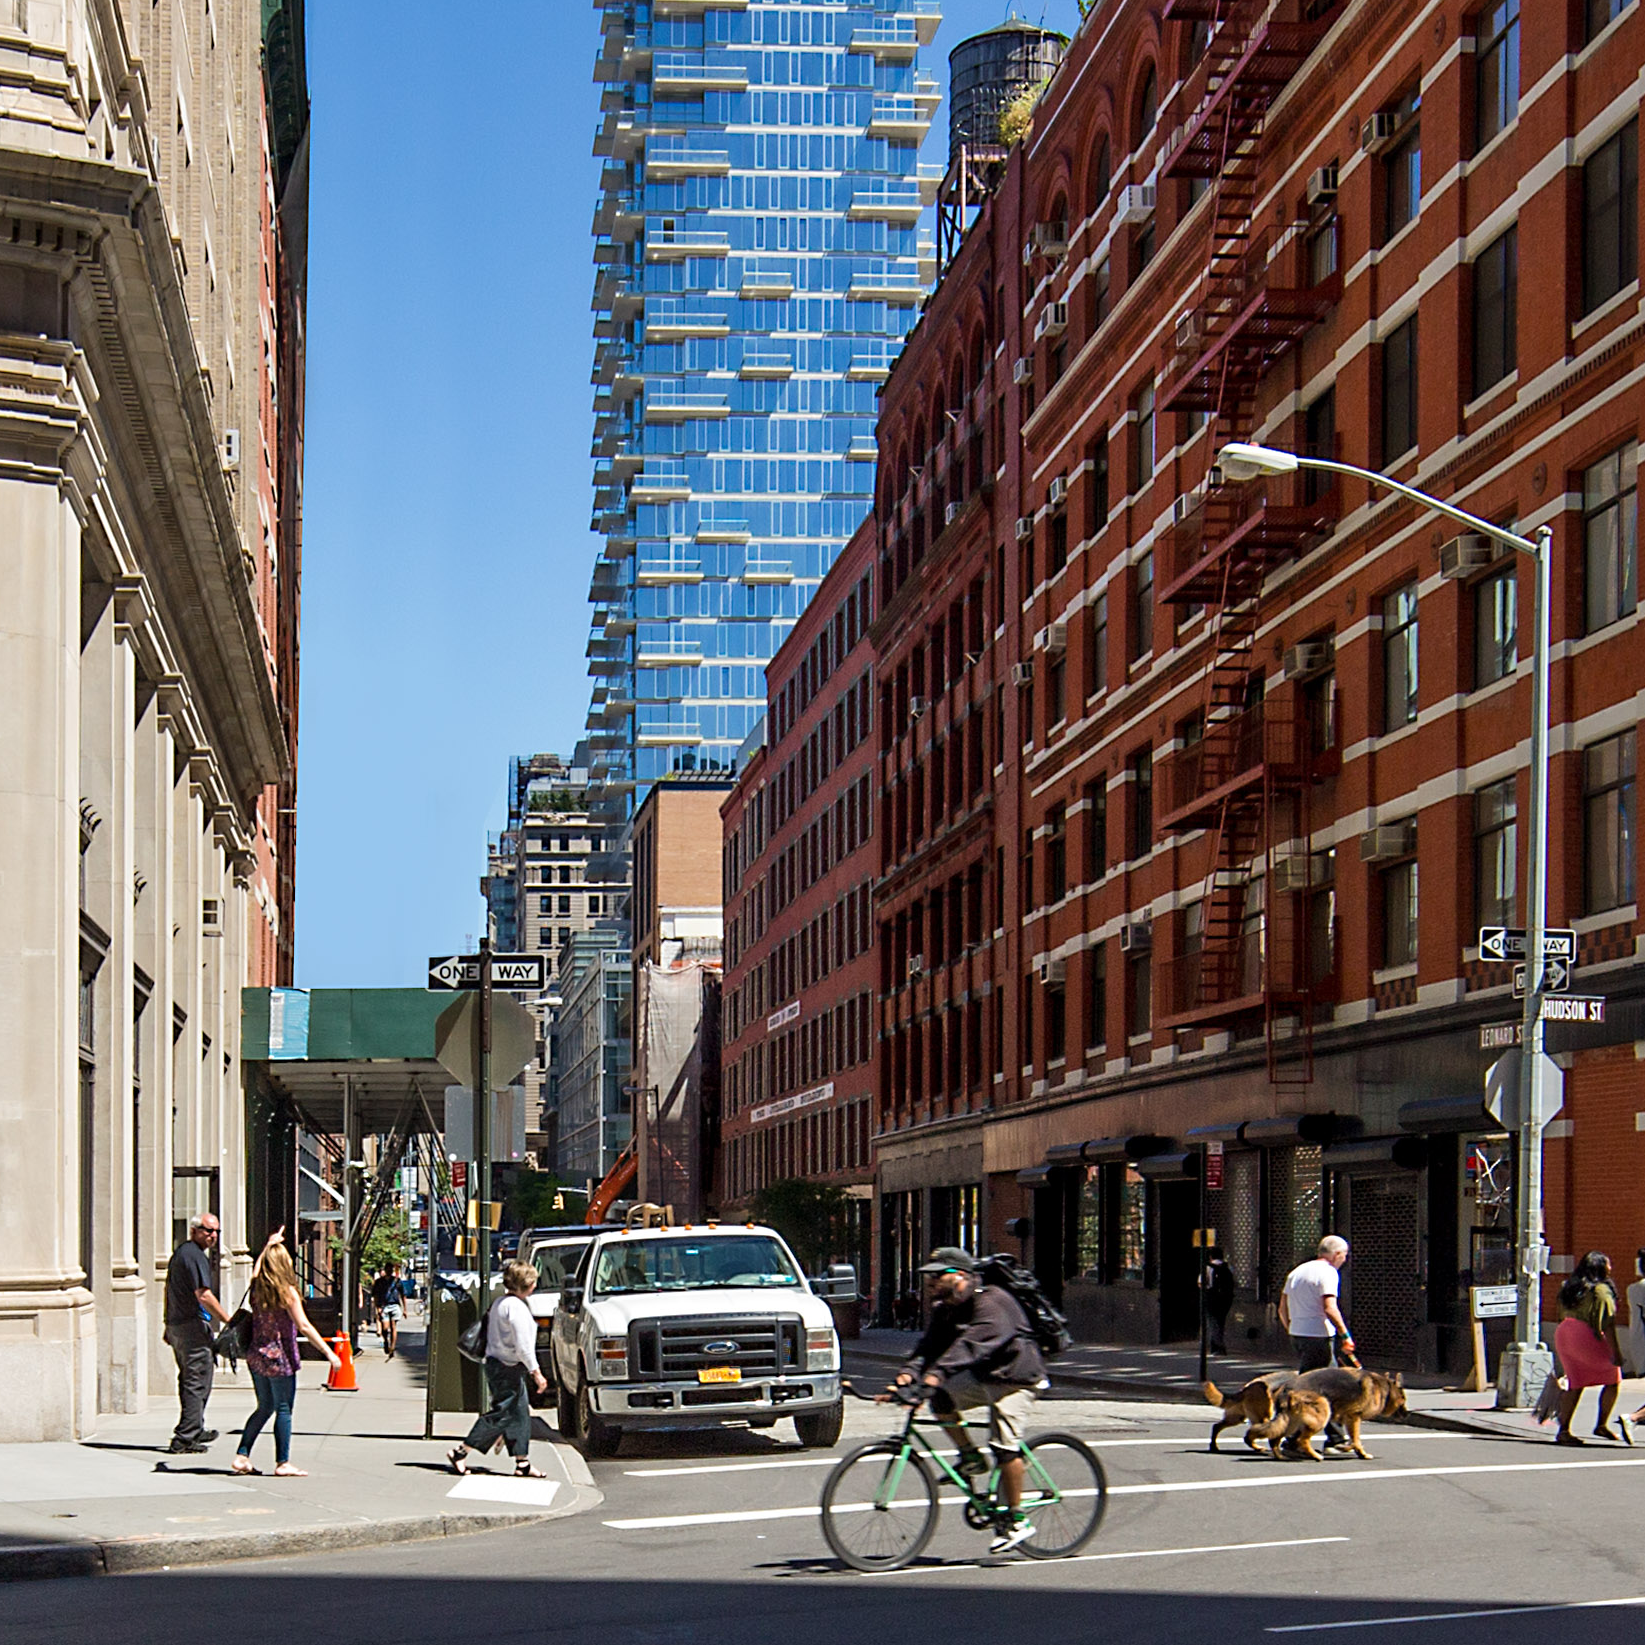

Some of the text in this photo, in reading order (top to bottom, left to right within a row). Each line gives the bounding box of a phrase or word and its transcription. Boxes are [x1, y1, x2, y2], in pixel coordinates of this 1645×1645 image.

[1491, 938, 1522, 951] ONE
[439, 965, 534, 979] ONE WAY
[1543, 1000, 1603, 1020] HUDSON ST
[1481, 1025, 1523, 1047] LEONARD S
